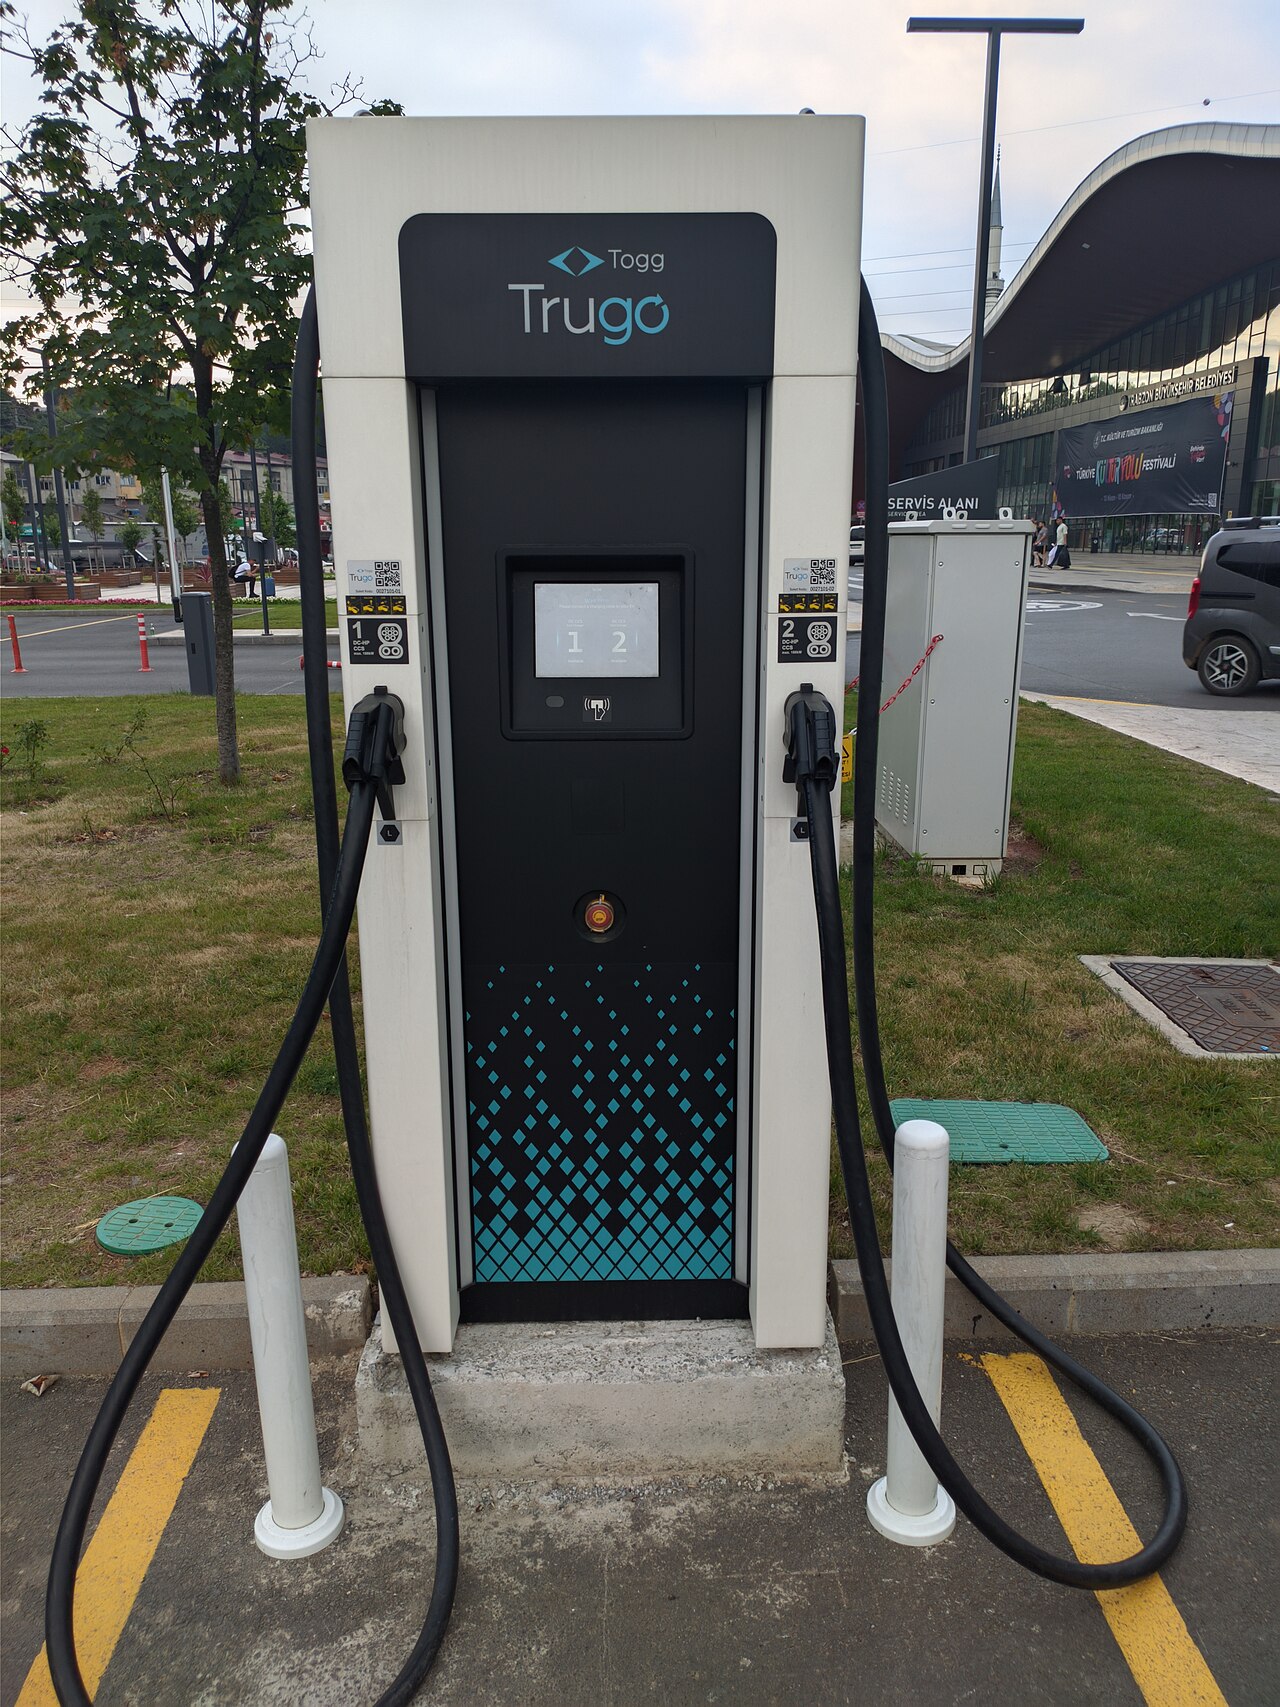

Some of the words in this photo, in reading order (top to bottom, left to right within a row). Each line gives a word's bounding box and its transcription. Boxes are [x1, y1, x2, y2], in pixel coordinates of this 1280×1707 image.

[608, 249, 665, 273] Togg
[508, 284, 670, 346] Trugo
[1194, 366, 1236, 391] BELEDİYESİ
[1076, 465, 1096, 480] TÜRKİYE
[1095, 456, 1121, 487] KÜLTÜR
[1120, 451, 1144, 482] YOLU
[1141, 453, 1176, 471] FESTİVALİ
[887, 494, 935, 510] SERVİS
[937, 497, 979, 510] ALANI
[349, 573, 373, 583] Trugo
[784, 571, 808, 581] Trugo
[352, 620, 362, 639] 1
[782, 619, 795, 638] 2
[568, 631, 584, 653] 1
[611, 630, 627, 653] 2
[387, 829, 393, 837] L
